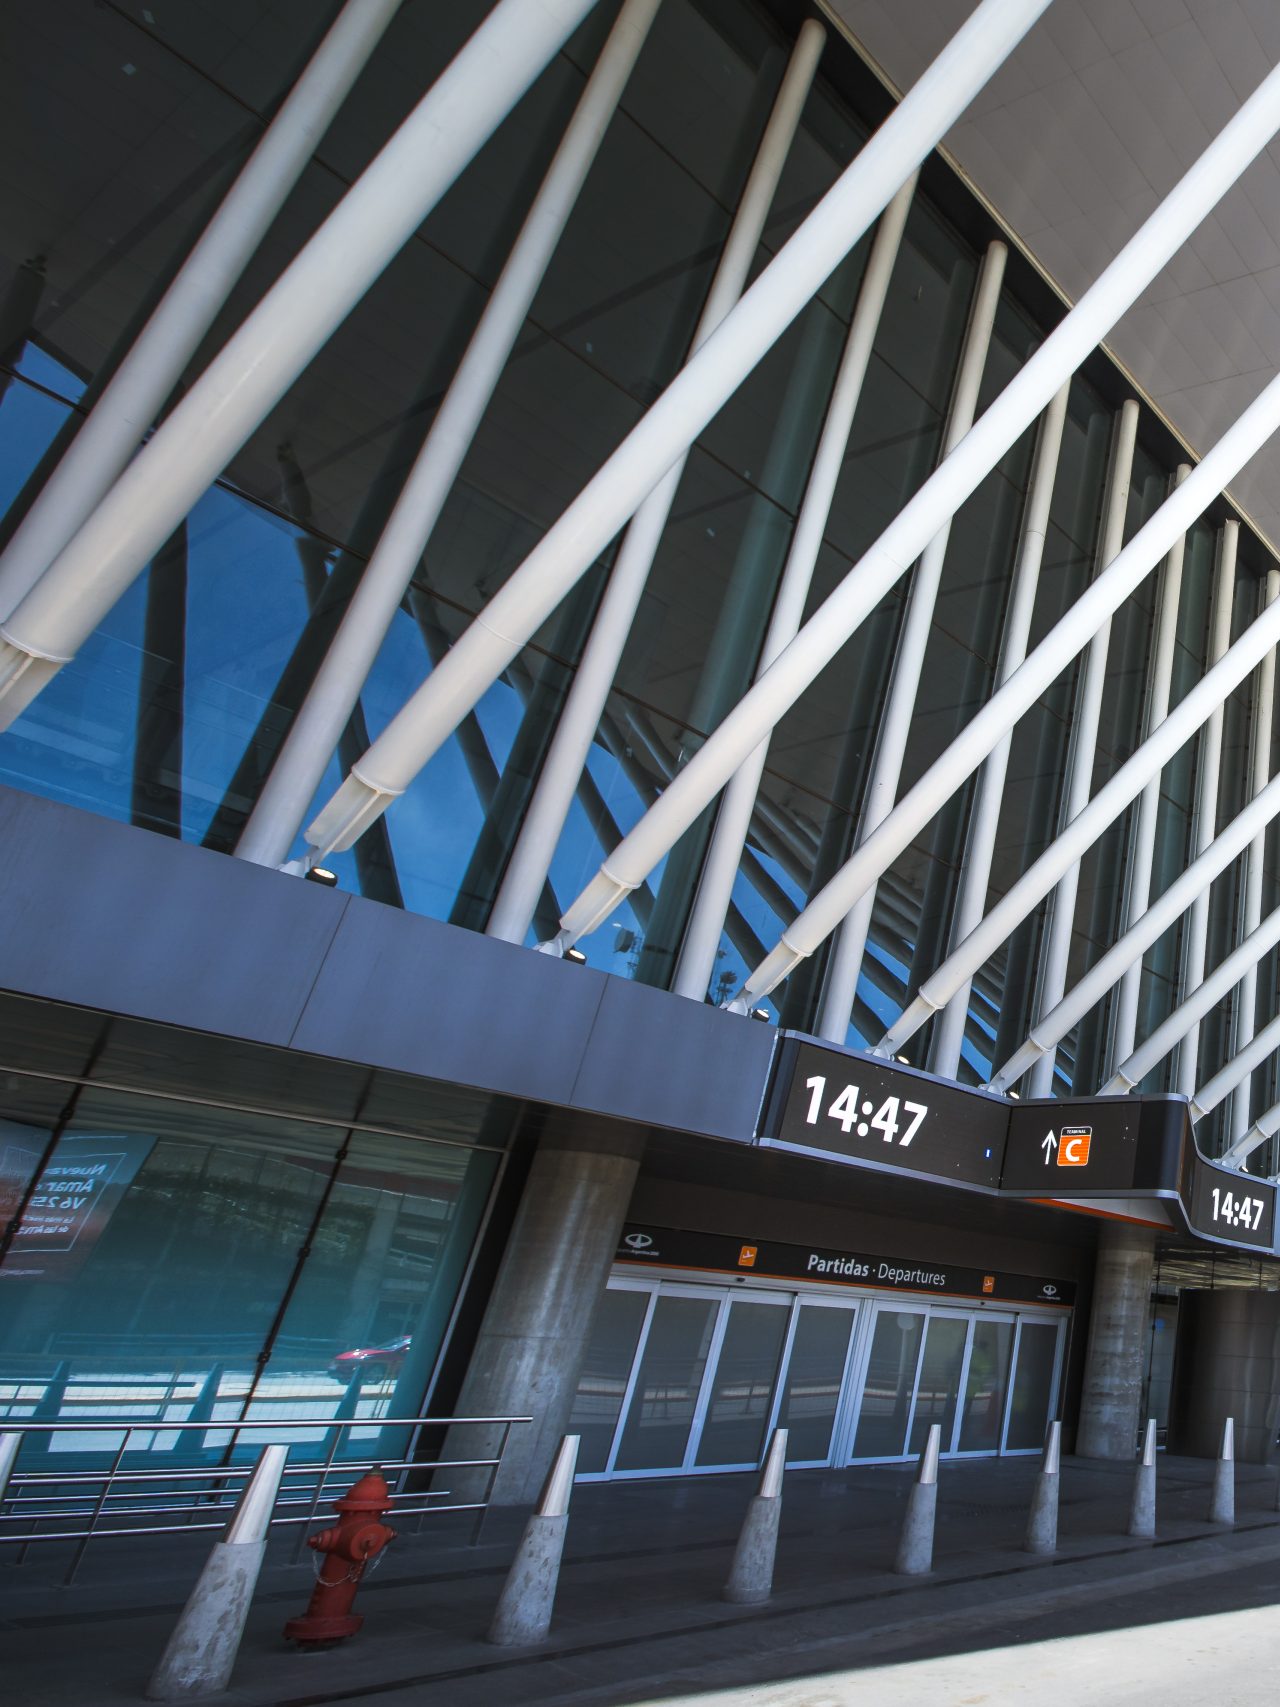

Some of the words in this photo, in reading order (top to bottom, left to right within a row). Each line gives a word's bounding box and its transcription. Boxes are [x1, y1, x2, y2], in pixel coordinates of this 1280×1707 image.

[806, 1076, 928, 1147] 14:47
[1065, 1138, 1083, 1162] C
[1212, 1187, 1264, 1231] 14:47
[807, 1254, 869, 1277] Partidas
[878, 1263, 946, 1286] Departures
